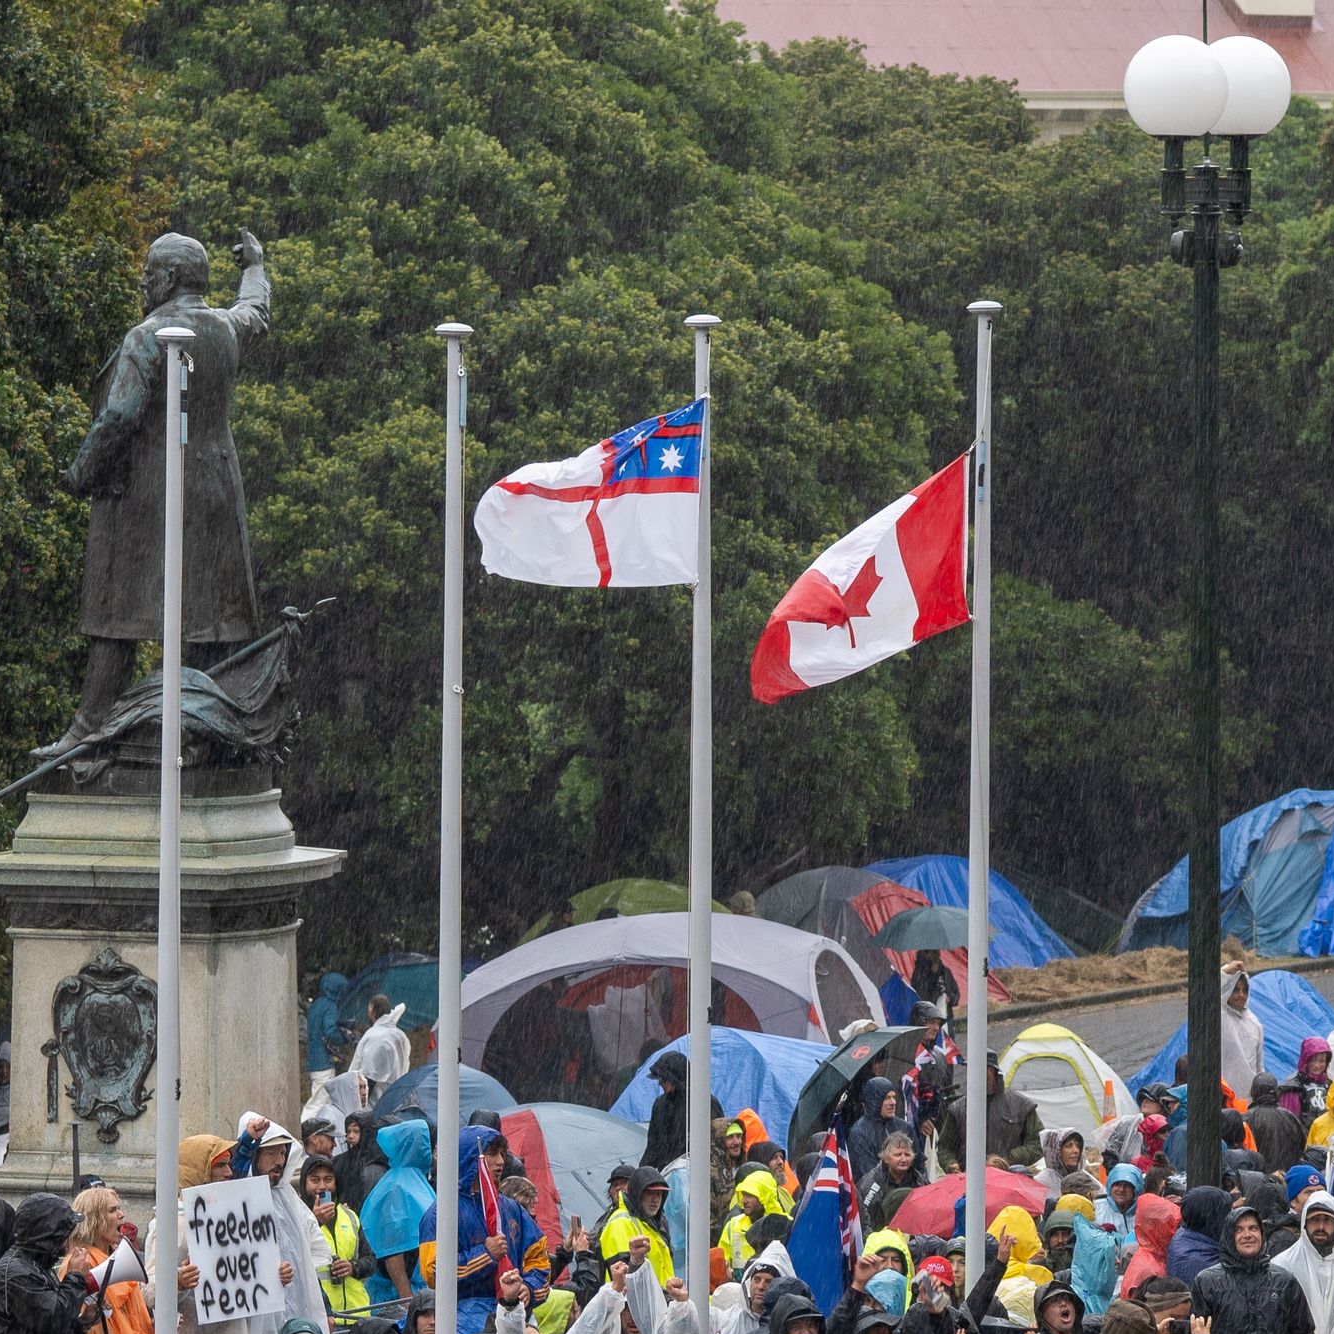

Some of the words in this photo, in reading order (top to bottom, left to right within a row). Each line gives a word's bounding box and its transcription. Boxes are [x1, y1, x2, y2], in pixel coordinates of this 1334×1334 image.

[189, 1195, 277, 1247] freedom
[216, 1252, 259, 1282] over
[201, 1280, 269, 1319] fear
